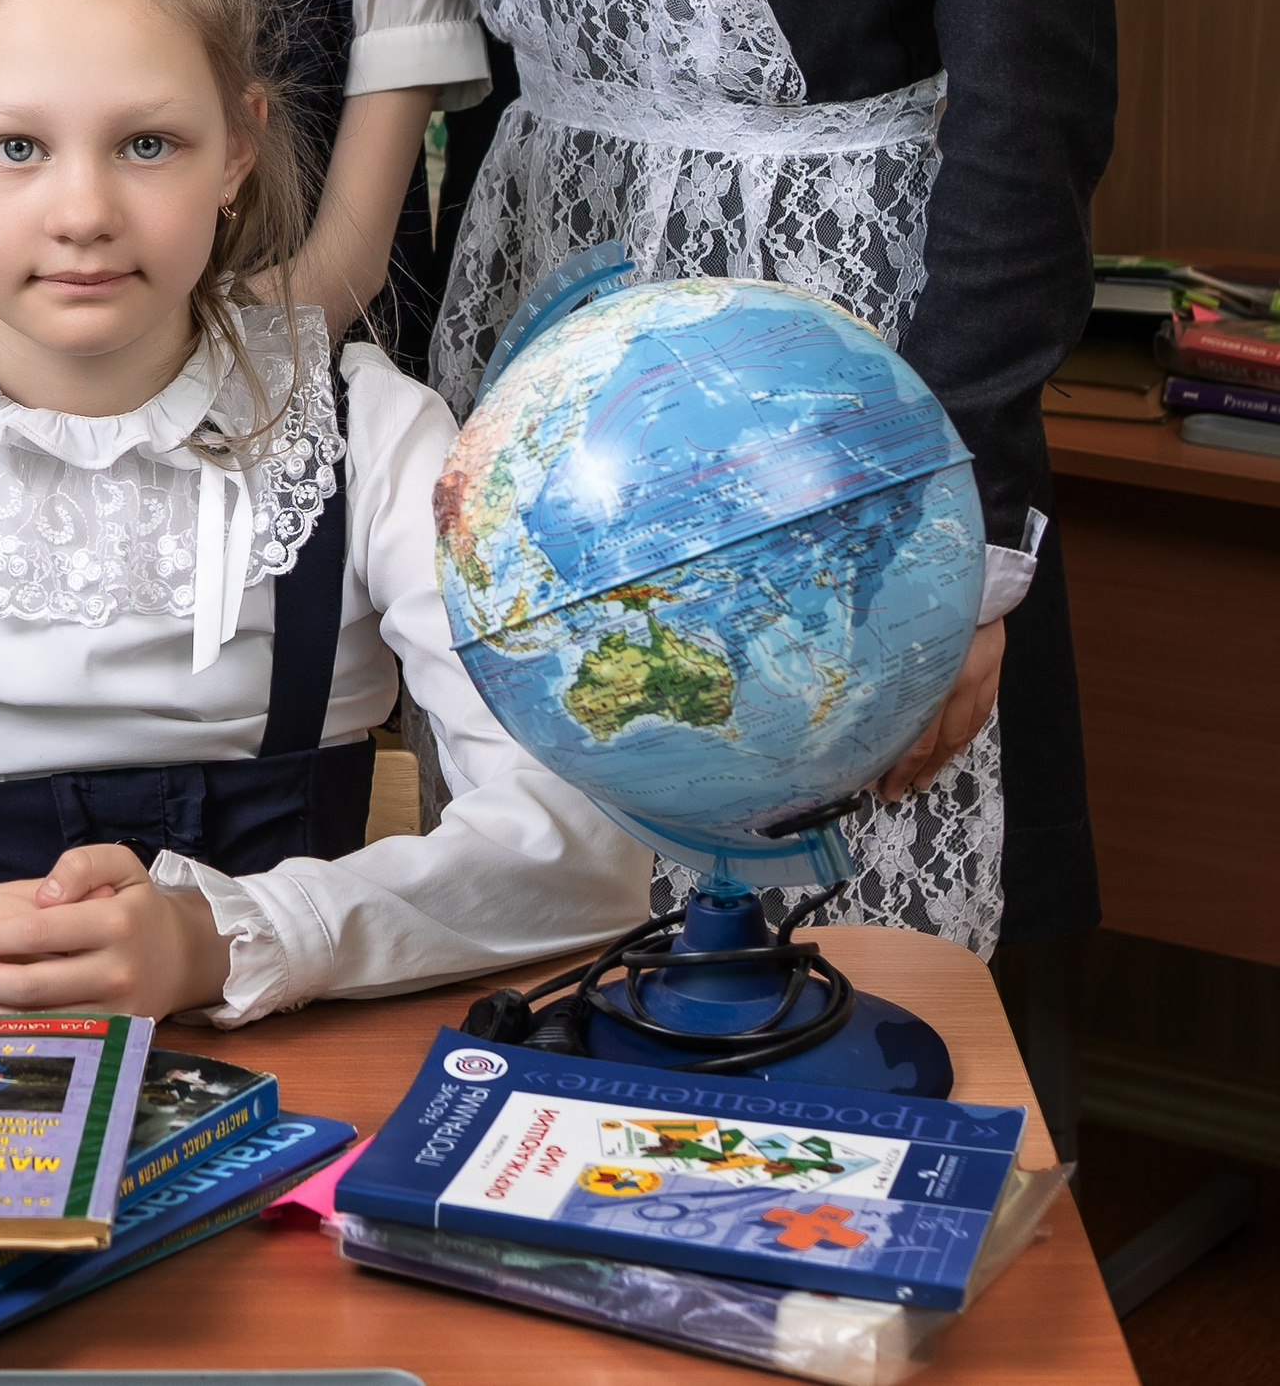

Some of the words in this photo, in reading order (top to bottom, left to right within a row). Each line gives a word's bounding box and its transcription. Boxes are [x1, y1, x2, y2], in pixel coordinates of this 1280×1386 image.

[414, 1084, 492, 1167] ПРОГРАММЫ
[418, 1082, 461, 1126] РАБОЧИЕ
[137, 1148, 180, 1187] УЧИТЕЛЯ
[484, 1107, 561, 1200] ОКРУЖАЮЩИЙ
[534, 1145, 568, 1177] МИР
